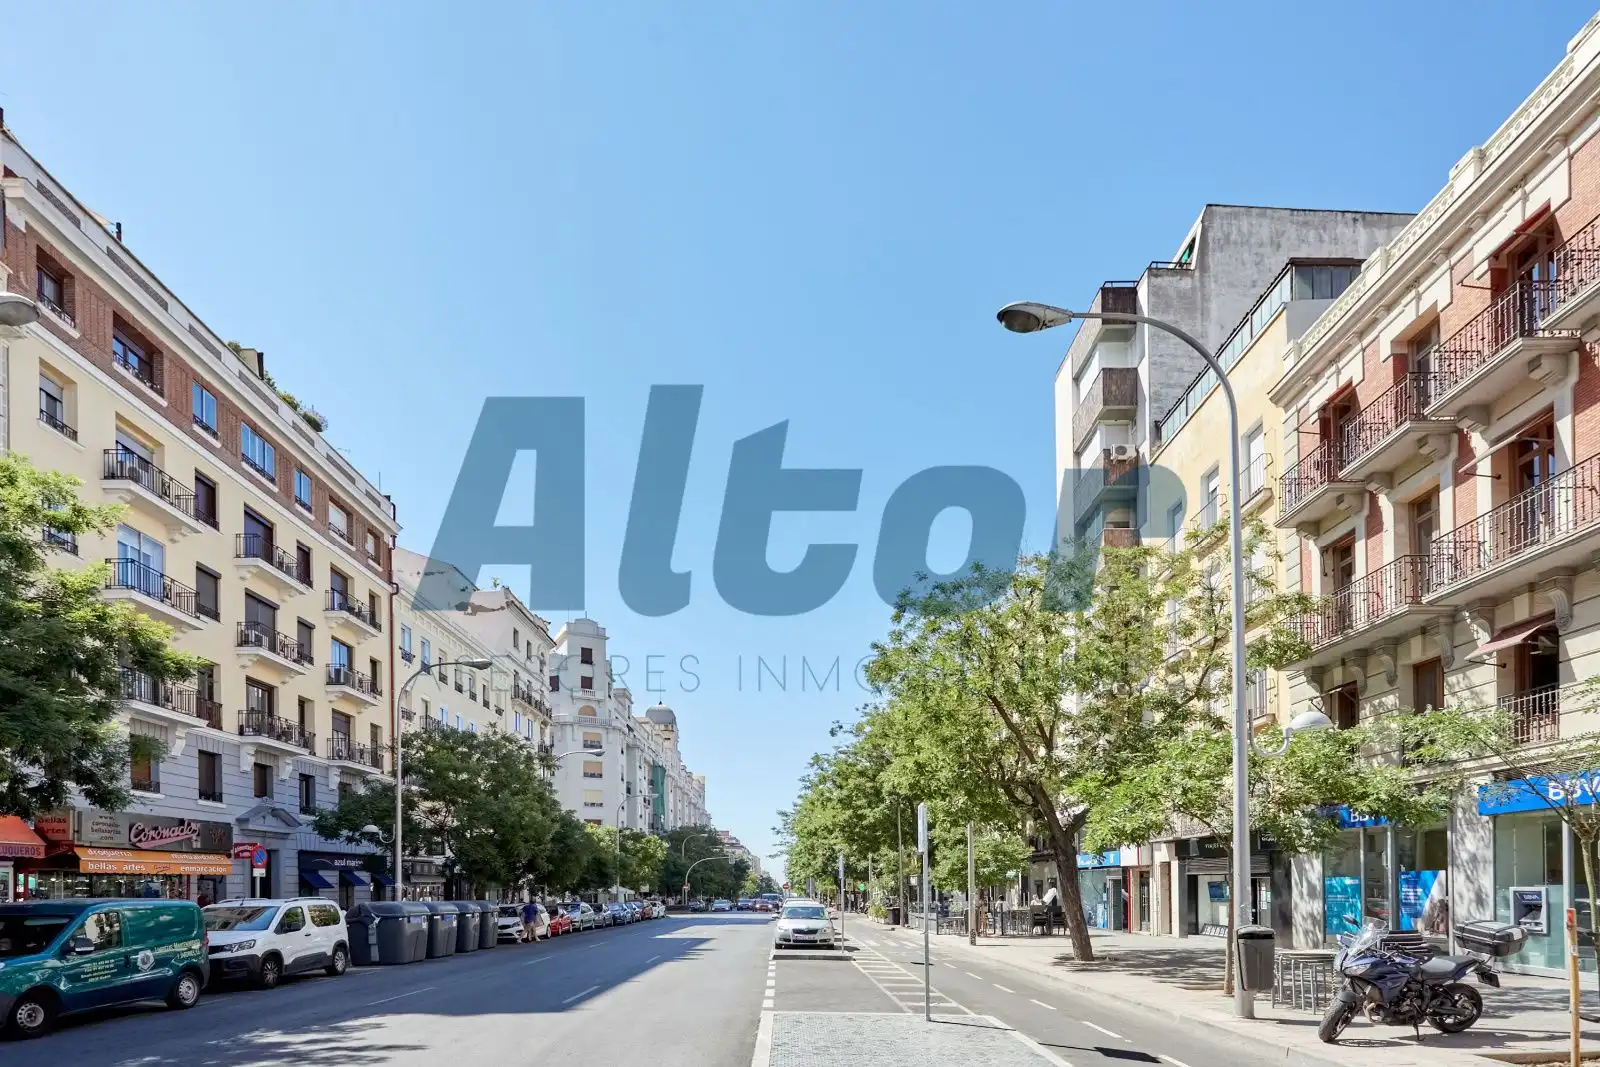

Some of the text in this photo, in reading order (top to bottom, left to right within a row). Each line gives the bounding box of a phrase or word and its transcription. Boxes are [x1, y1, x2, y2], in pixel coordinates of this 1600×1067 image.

[0, 845, 42, 856] UQUEROS
[88, 862, 117, 871] bellas
[122, 863, 146, 871] artes
[334, 858, 346, 866] azul
